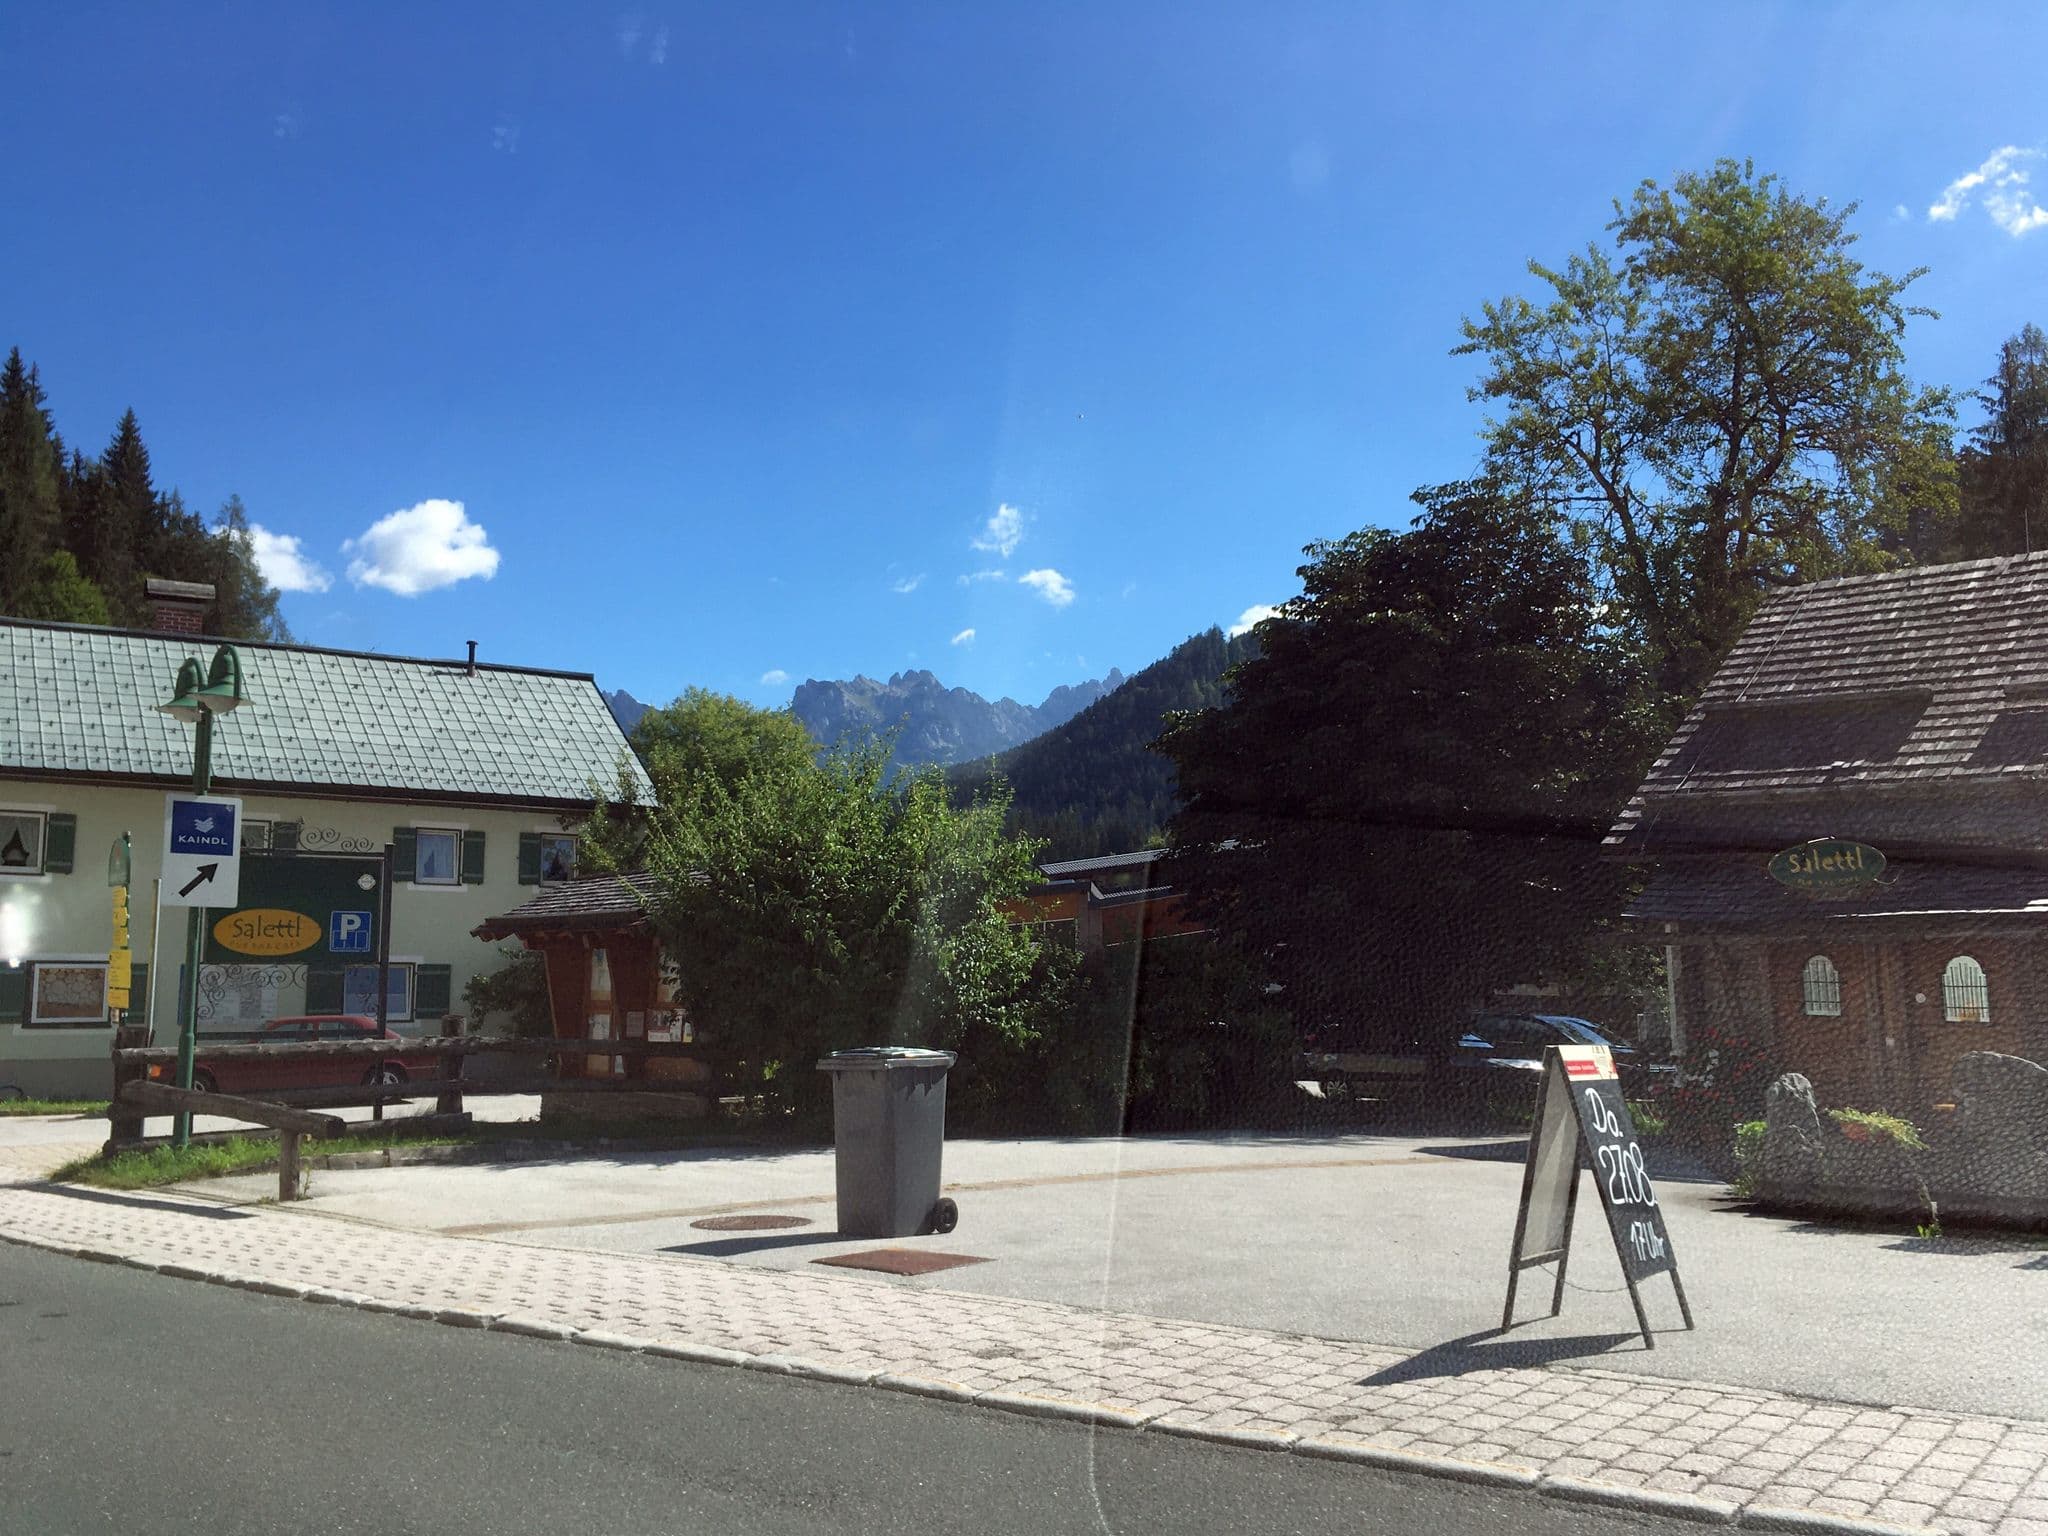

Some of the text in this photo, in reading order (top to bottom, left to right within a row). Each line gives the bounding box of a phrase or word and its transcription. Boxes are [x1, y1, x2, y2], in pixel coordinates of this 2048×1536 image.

[178, 834, 228, 846] KAINDL
[232, 914, 303, 940] Salettl
[340, 913, 362, 940] P
[1585, 1087, 1624, 1138] Do.
